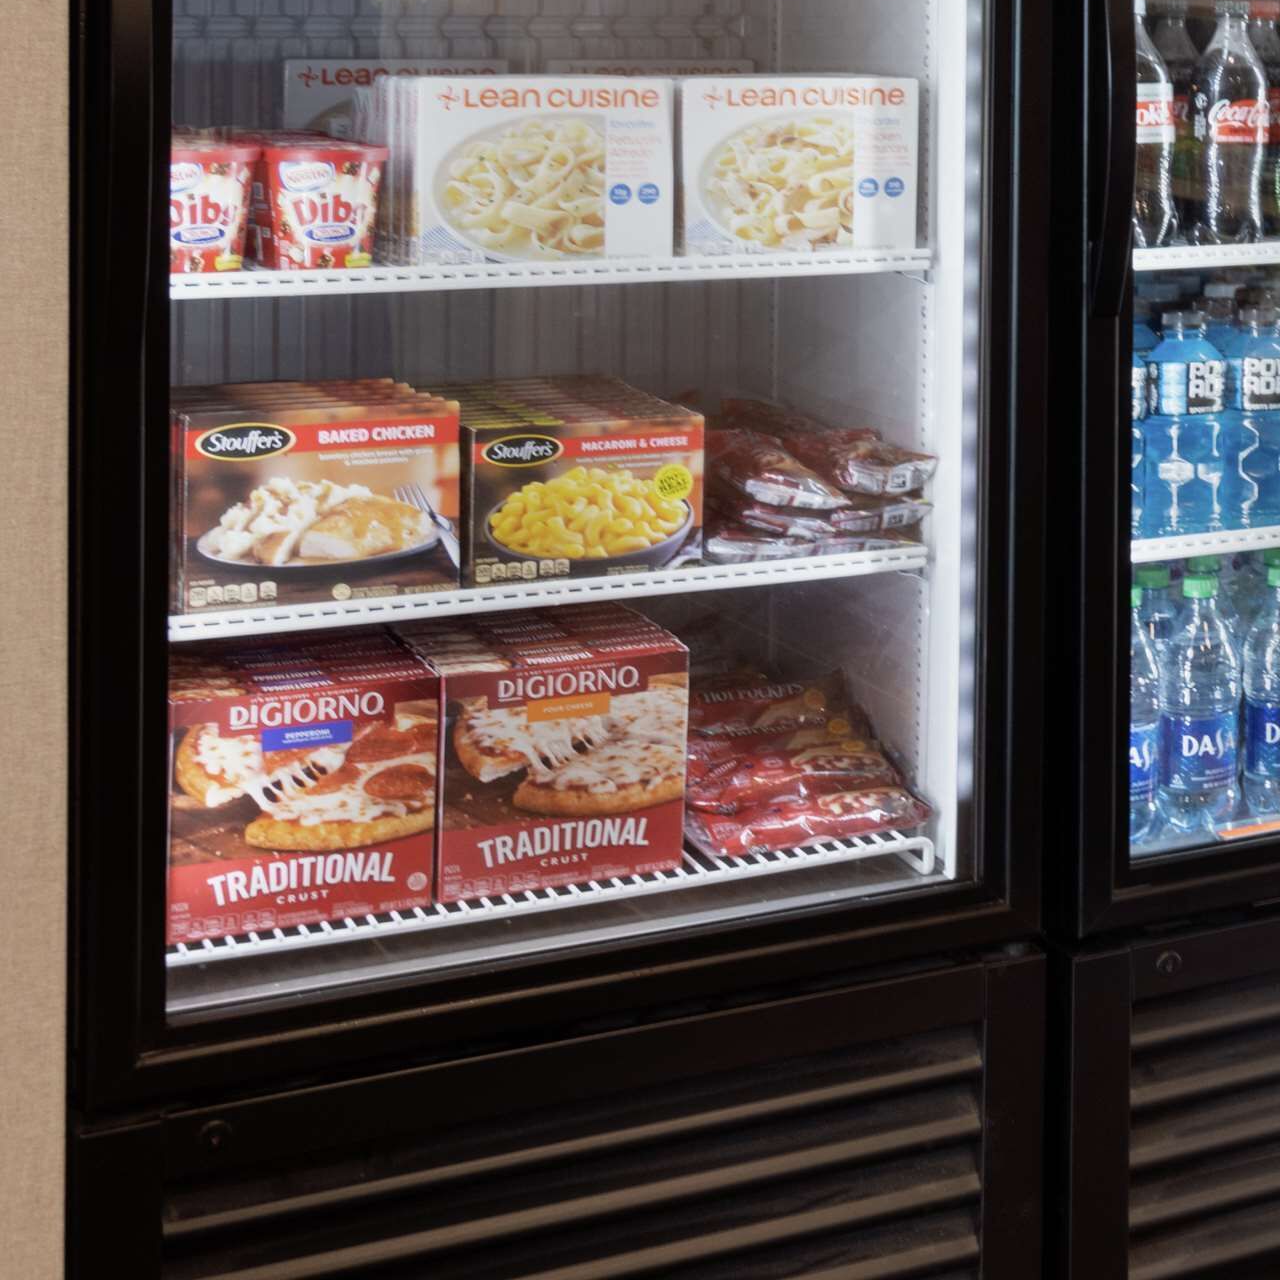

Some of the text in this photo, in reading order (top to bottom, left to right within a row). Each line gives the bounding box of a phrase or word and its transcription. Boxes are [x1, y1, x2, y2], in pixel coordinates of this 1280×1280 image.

[463, 86, 542, 109] Lean
[726, 84, 798, 108] Lean
[207, 424, 435, 453] Stouffer's BAKED CHICKEN
[492, 441, 554, 461] Stouffer's
[581, 439, 637, 452] MACARONI
[649, 436, 688, 447] CHEESE
[477, 818, 650, 869] TRADITIONAL
[540, 852, 589, 868] CRUST
[207, 851, 396, 907] TRADITIONAL
[276, 889, 330, 906] CRUST
